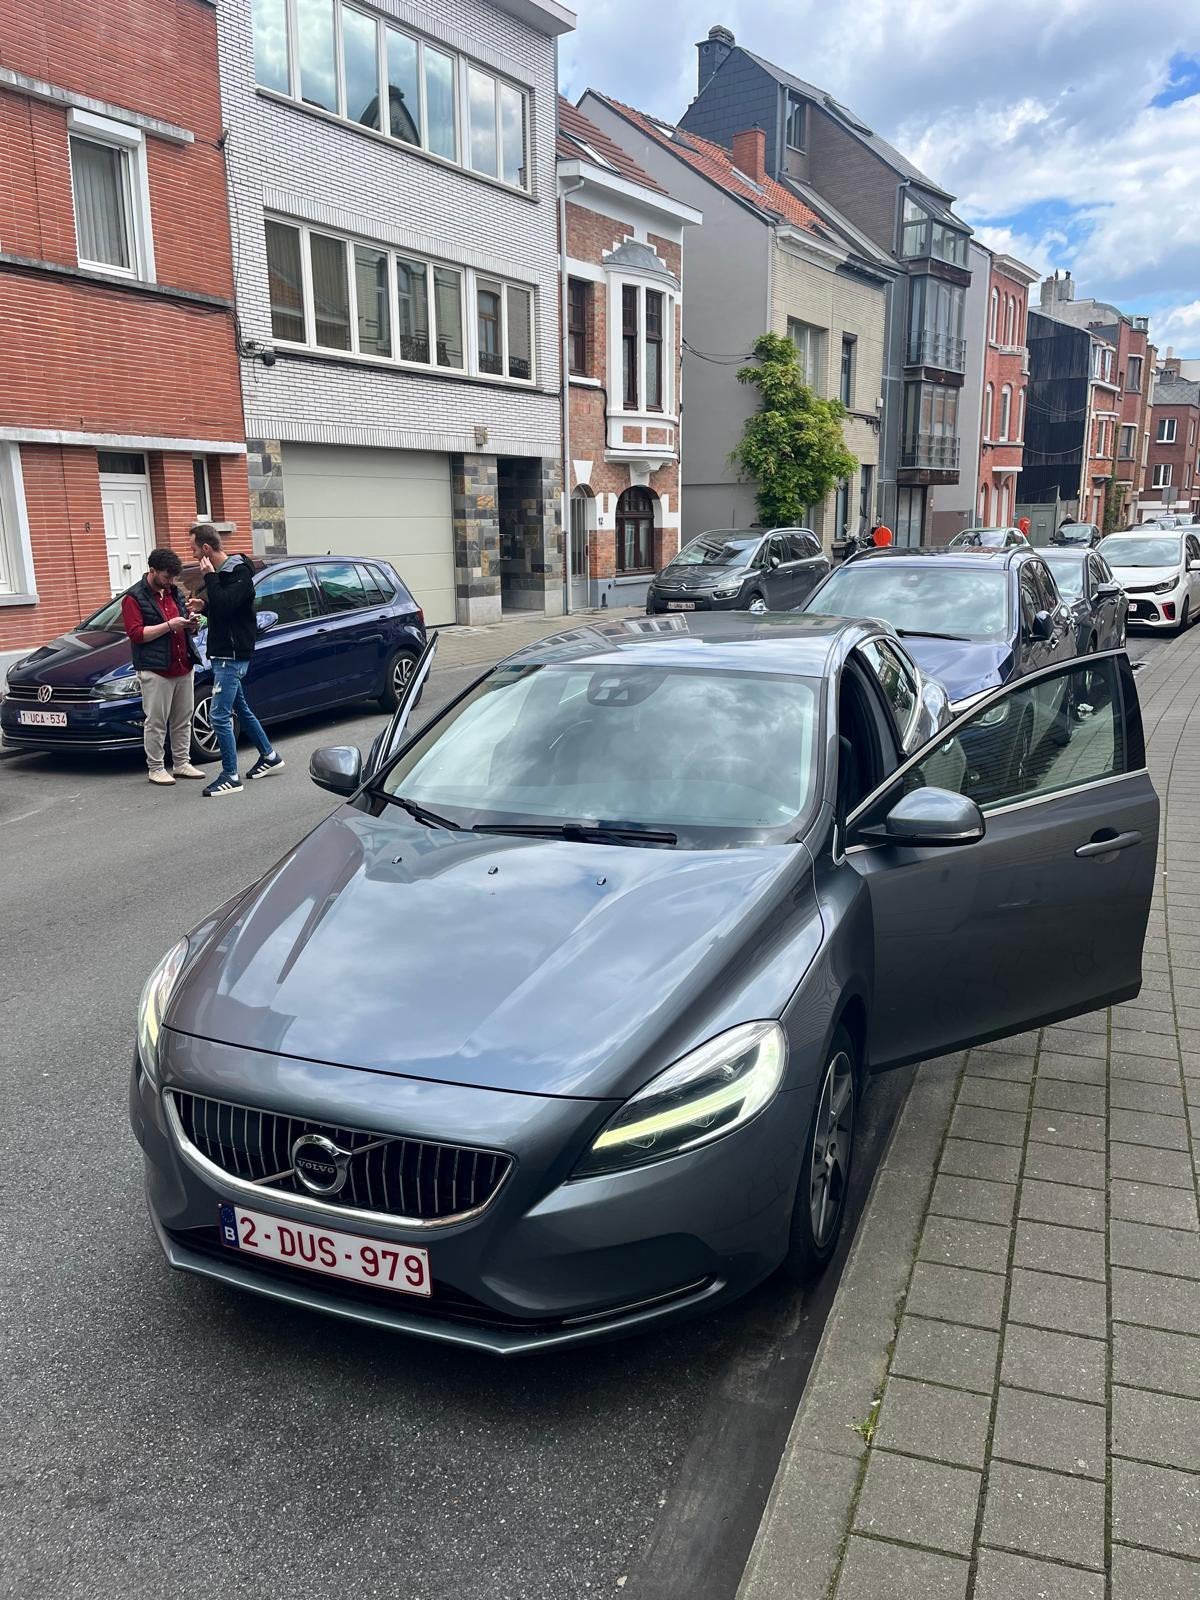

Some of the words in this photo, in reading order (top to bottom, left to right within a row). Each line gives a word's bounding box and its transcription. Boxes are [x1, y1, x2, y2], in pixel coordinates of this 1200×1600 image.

[296, 1159, 335, 1174] VOLVO
[224, 1226, 236, 1241] B
[239, 1216, 425, 1287] 2-DUS-979
